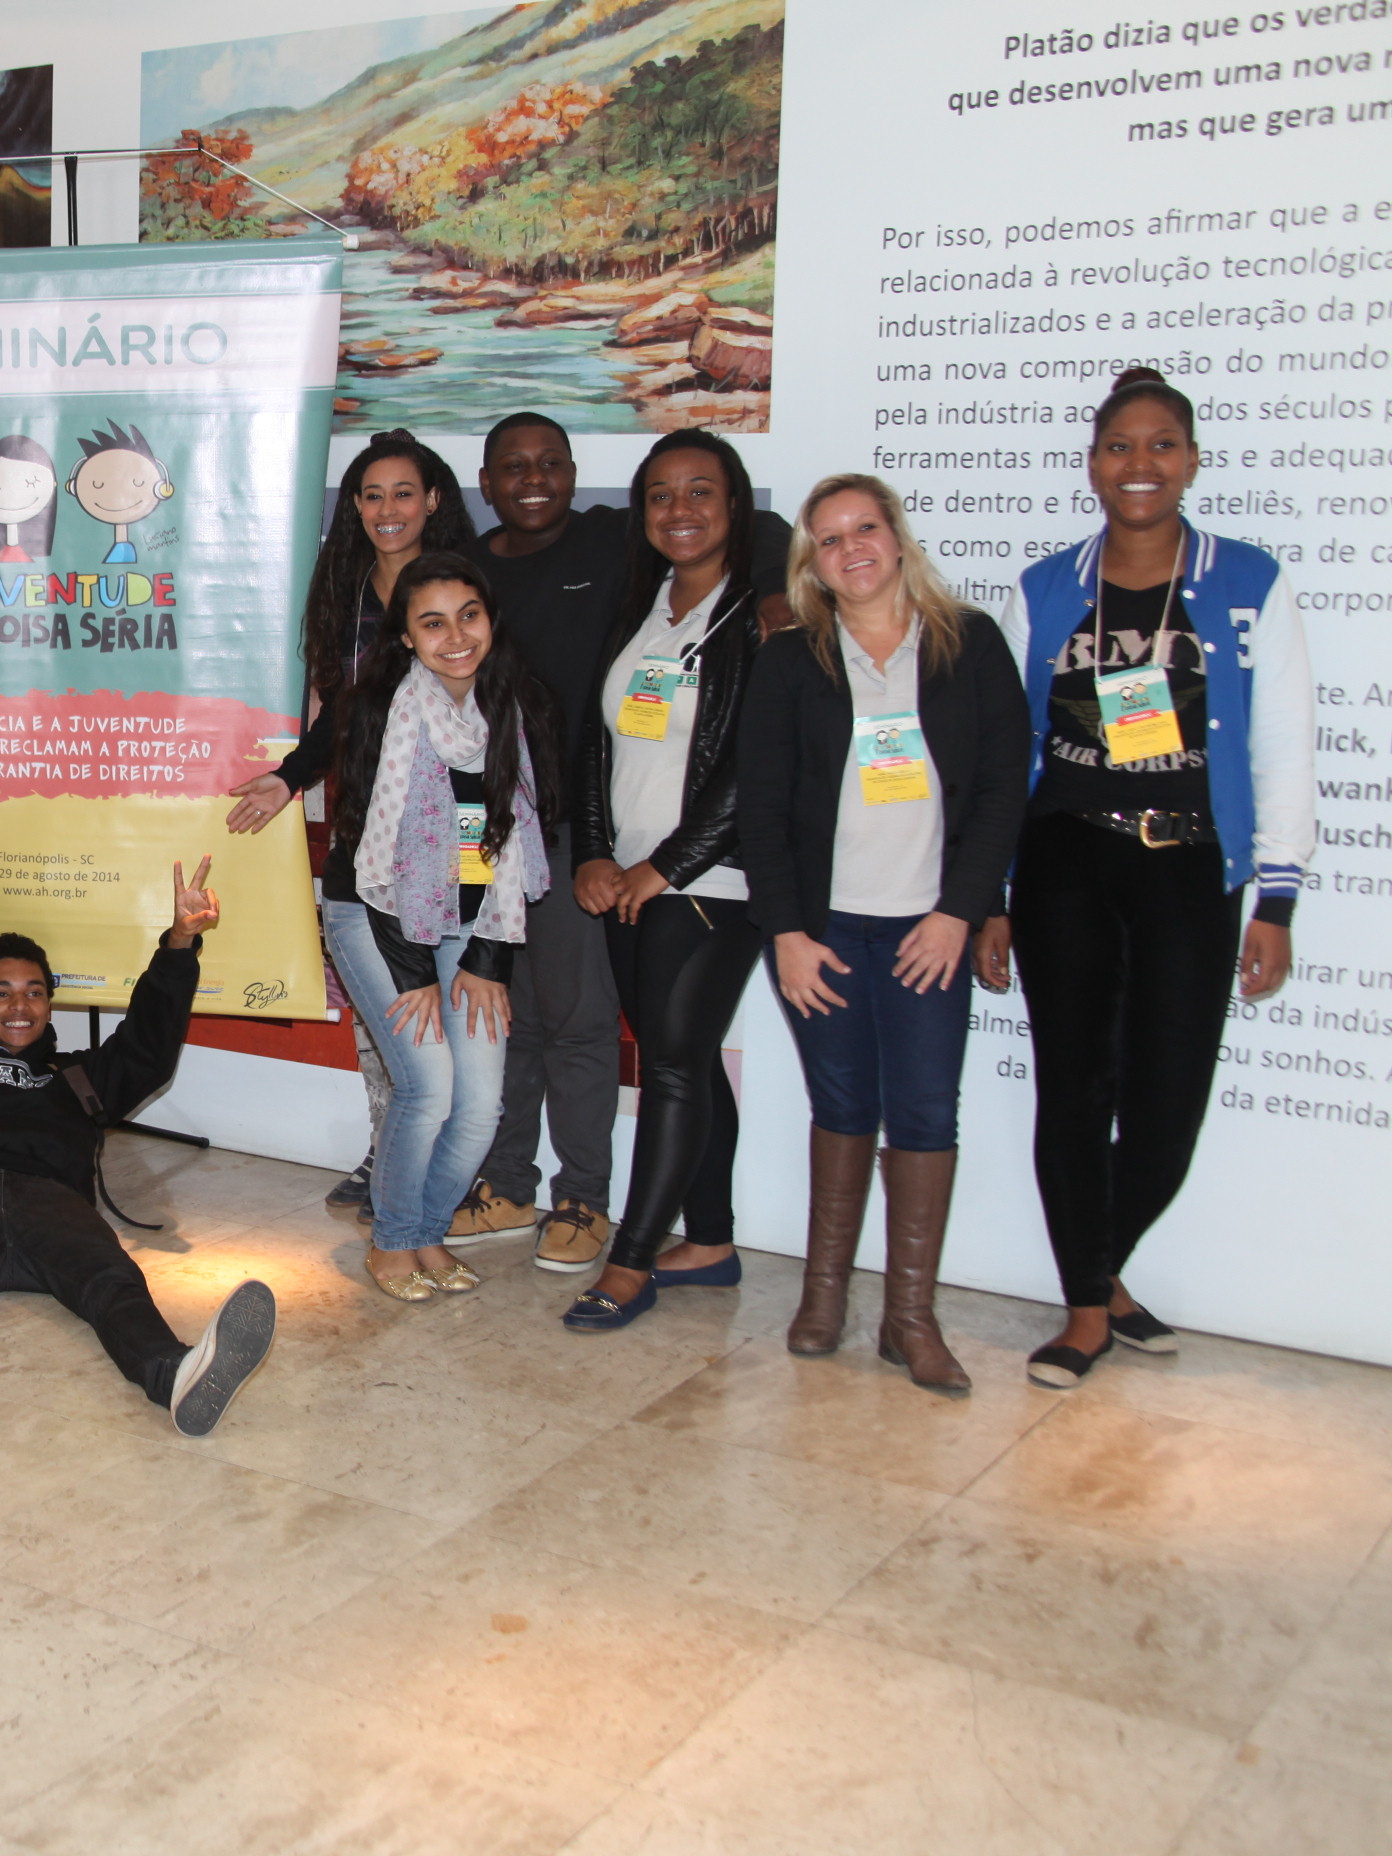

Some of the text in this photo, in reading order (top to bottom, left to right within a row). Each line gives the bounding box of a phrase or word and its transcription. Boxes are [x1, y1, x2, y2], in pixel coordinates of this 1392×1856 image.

[1004, 0, 1392, 59] Platão dizia que os verda
[948, 85, 999, 116] que
[1009, 68, 1203, 106] desenvolvem
[1214, 60, 1282, 87] uma
[1293, 49, 1372, 78] nova
[1128, 117, 1188, 142] mas
[1198, 112, 1256, 142] que
[1265, 105, 1335, 137] gera
[882, 227, 925, 250] Por
[936, 224, 992, 249] isso,
[1005, 216, 1135, 249] podemos
[1147, 208, 1257, 236] afirmar
[1270, 204, 1328, 233] que
[1342, 203, 1359, 223] a
[880, 264, 1032, 294] relacionada
[1044, 262, 1058, 287] à
[1070, 256, 1210, 288] revolução
[878, 308, 1086, 338] industrializados
[1096, 312, 1111, 331] e
[1121, 311, 1136, 330] a
[1146, 298, 1306, 332] aceleração
[1318, 295, 1354, 322] da
[877, 362, 931, 382] uma
[944, 360, 1007, 381] nova
[1227, 347, 1263, 374] do
[875, 402, 928, 431] pela
[938, 400, 1054, 425] indústria
[1197, 396, 1249, 421] dos
[1259, 393, 1372, 420] séculos
[873, 446, 1031, 469] ferramentas
[1241, 449, 1258, 468] e
[903, 489, 934, 513] de
[945, 489, 1033, 514] dentro
[1044, 496, 1060, 514] e
[1198, 490, 1303, 519] ateliês,
[1317, 496, 1392, 515] reno
[939, 539, 1011, 557] como
[1319, 537, 1356, 563] de
[79, 608, 178, 653] SÉRIA
[32, 716, 44, 731] E
[50, 717, 61, 732] A
[69, 716, 186, 734] JUVENTUDE
[99, 741, 110, 757] A
[117, 739, 211, 763] PROTEÇÃO
[1052, 742, 1099, 767] AIR
[70, 763, 92, 780] DE
[99, 765, 185, 783] DIREITOS
[80, 854, 95, 865] SC
[15, 869, 29, 880] de
[32, 870, 71, 883] agosto
[74, 871, 88, 882] de
[91, 872, 121, 883] 2014
[3, 887, 88, 900] www.ah.org.br
[1269, 1000, 1302, 1026] da
[997, 1055, 1026, 1079] da
[1260, 1050, 1375, 1081] sonhos.
[1220, 1084, 1254, 1111] da
